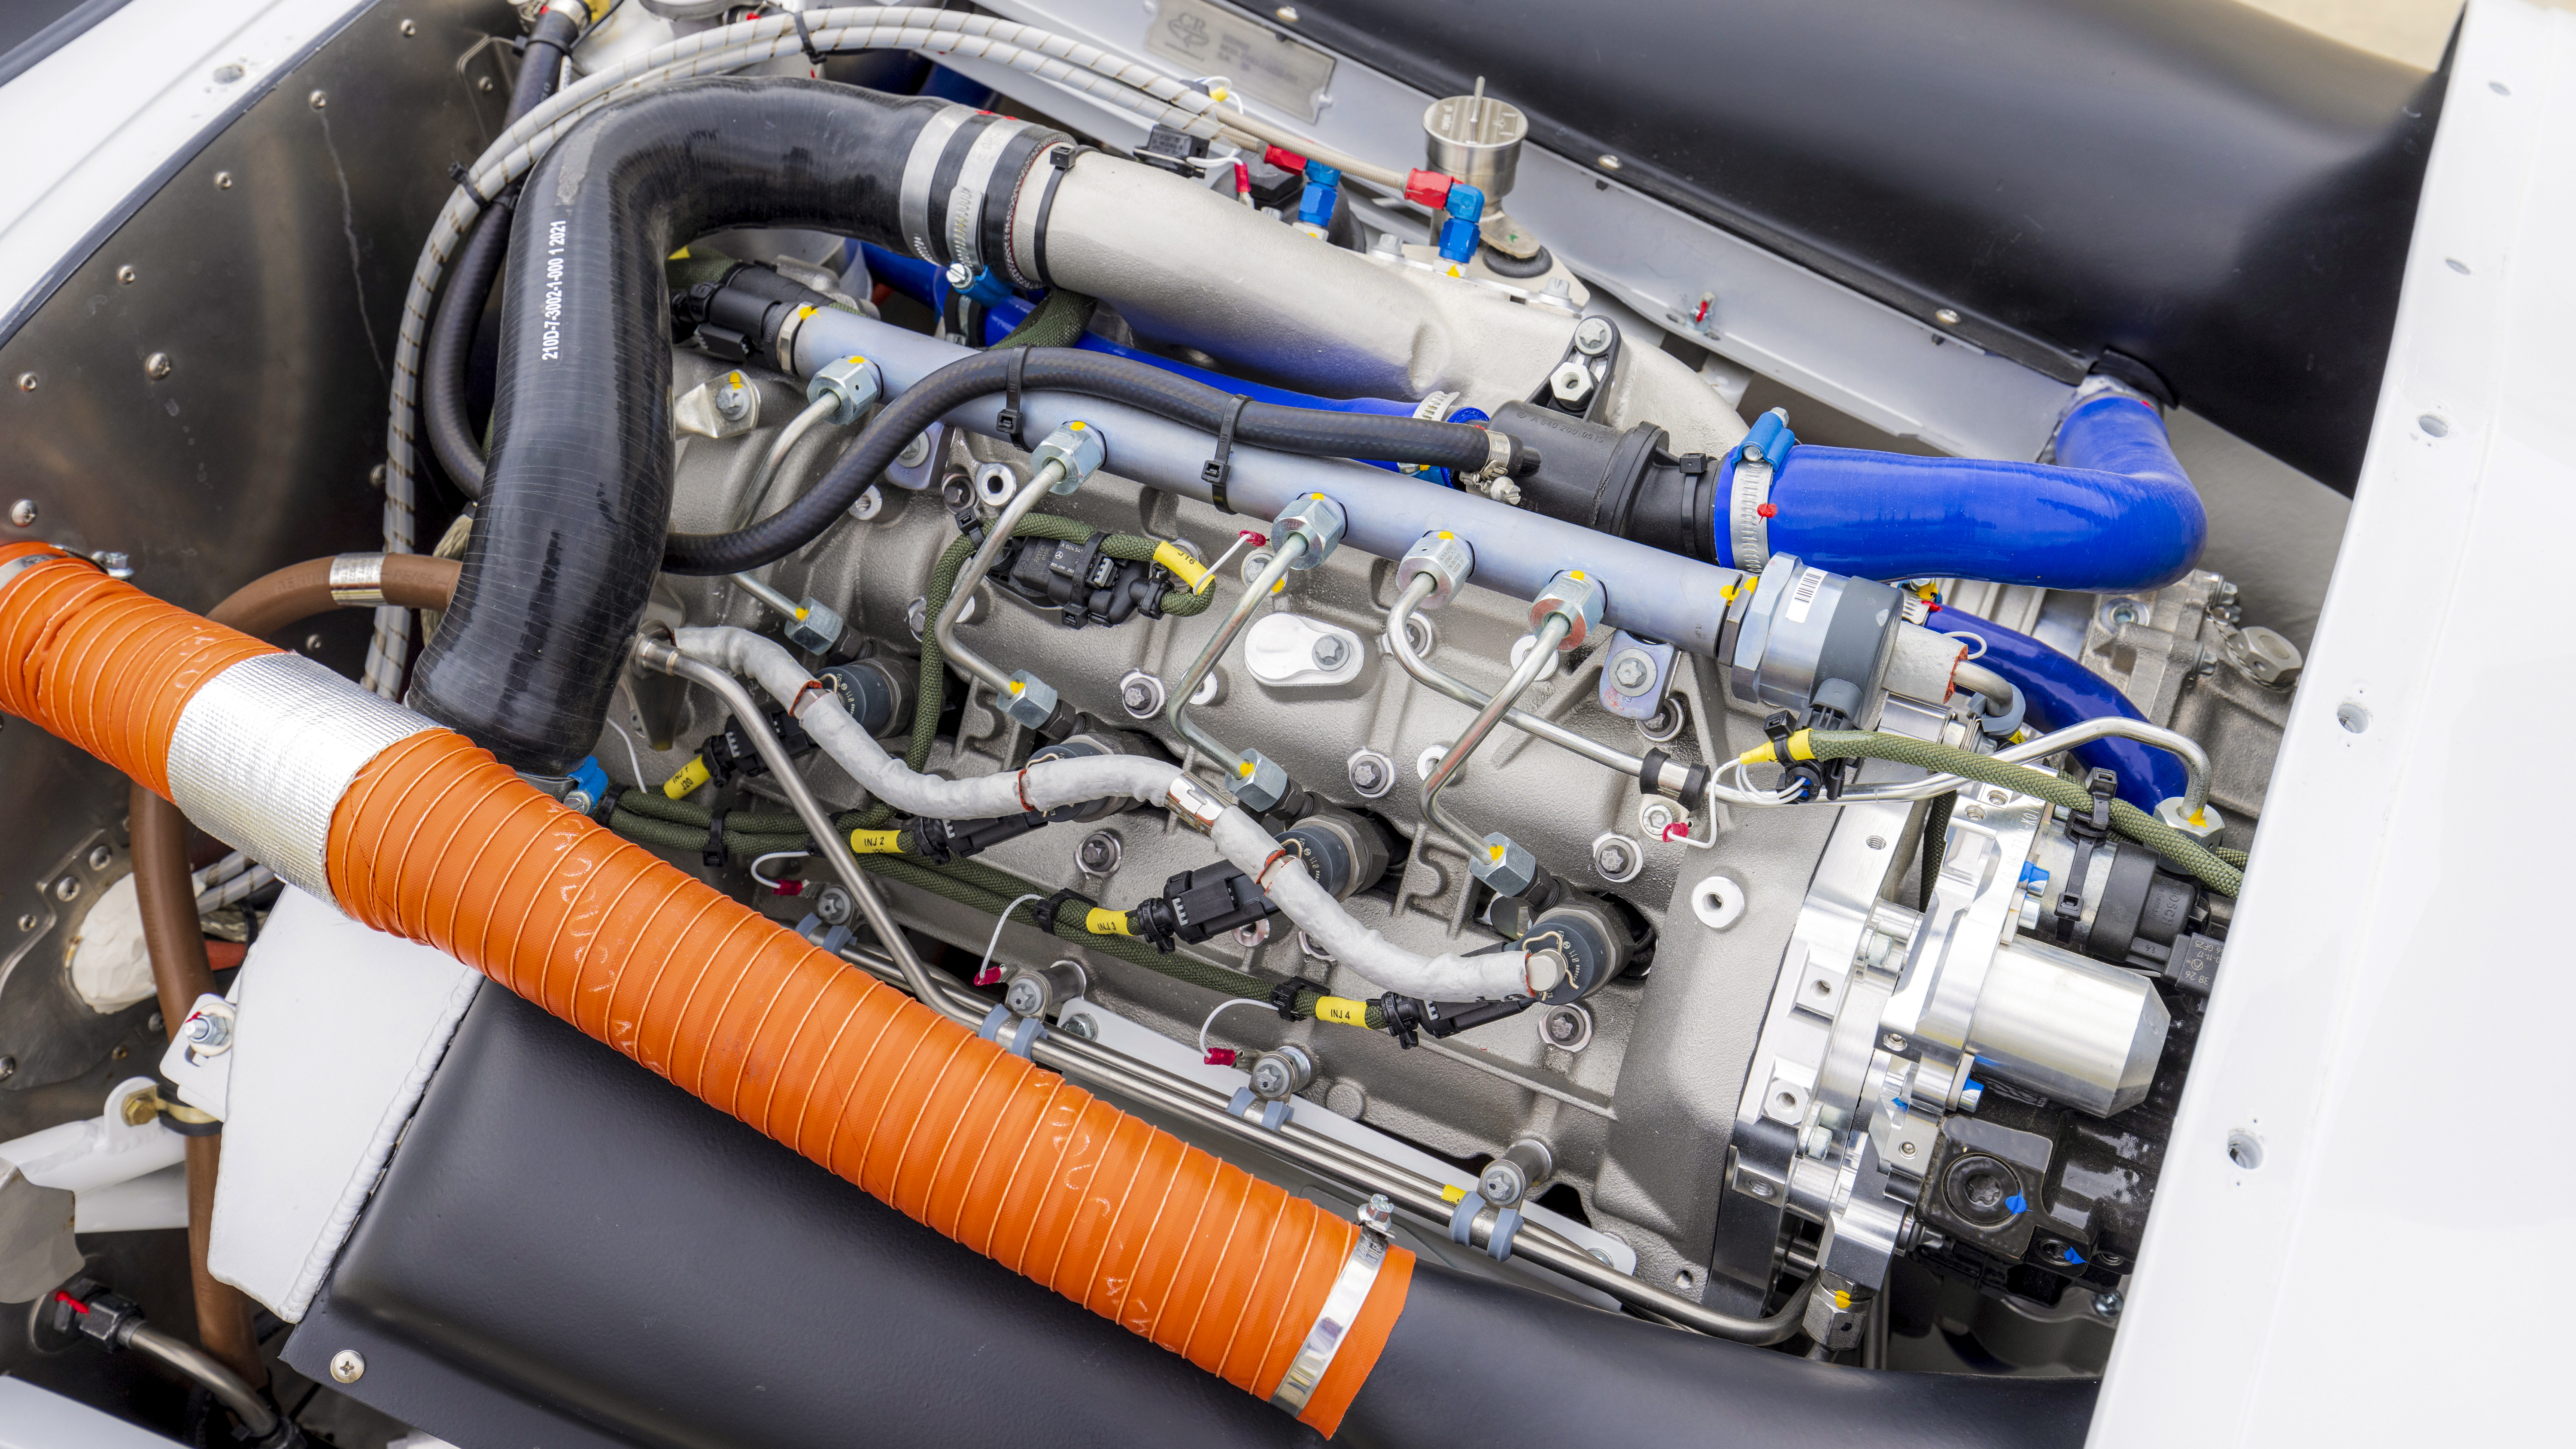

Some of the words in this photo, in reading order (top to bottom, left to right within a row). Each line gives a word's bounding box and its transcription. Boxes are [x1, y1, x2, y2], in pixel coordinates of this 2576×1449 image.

[549, 220, 566, 247] 2021
[542, 258, 564, 360] 210D-7-3002-1-000
[1042, 548, 1050, 561] 0108
[1178, 552, 1196, 565] J16
[673, 770, 682, 784] INJ
[680, 778, 693, 790] J20
[864, 837, 877, 847] INJ
[880, 836, 884, 845] 2
[2162, 887, 2181, 926] BOSCH
[1097, 922, 1110, 931] INJ
[1111, 921, 1116, 930] 3
[2185, 970, 2196, 980] 26
[2198, 975, 2210, 985] 38
[1331, 1009, 1342, 1018] INJ
[1345, 1011, 1350, 1020] 4
